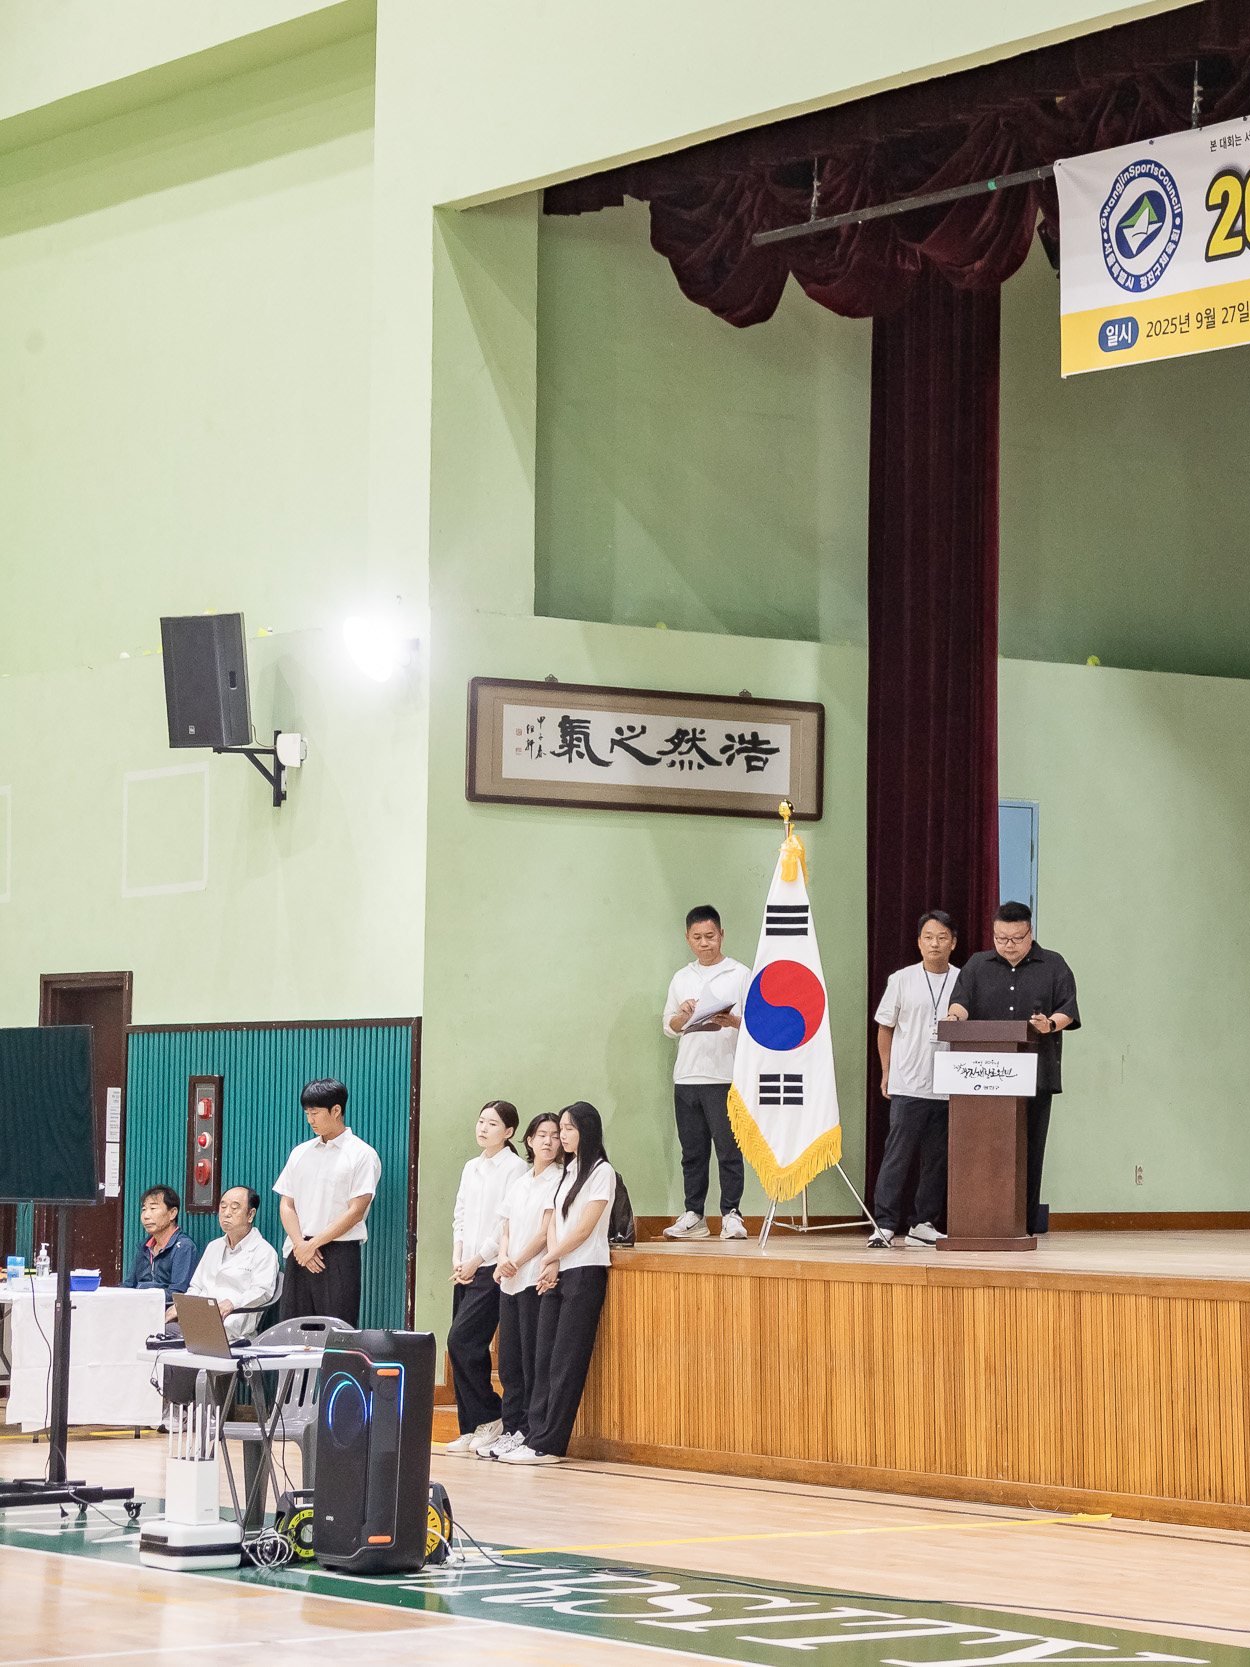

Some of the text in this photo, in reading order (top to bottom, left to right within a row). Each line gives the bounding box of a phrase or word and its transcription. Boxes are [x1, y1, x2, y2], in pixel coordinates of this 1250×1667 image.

[1209, 140, 1218, 152] 본
[1219, 134, 1242, 149] 대회는
[1105, 321, 1132, 347] 일시
[1146, 312, 1191, 338] 2025년
[1196, 307, 1216, 330] 9월
